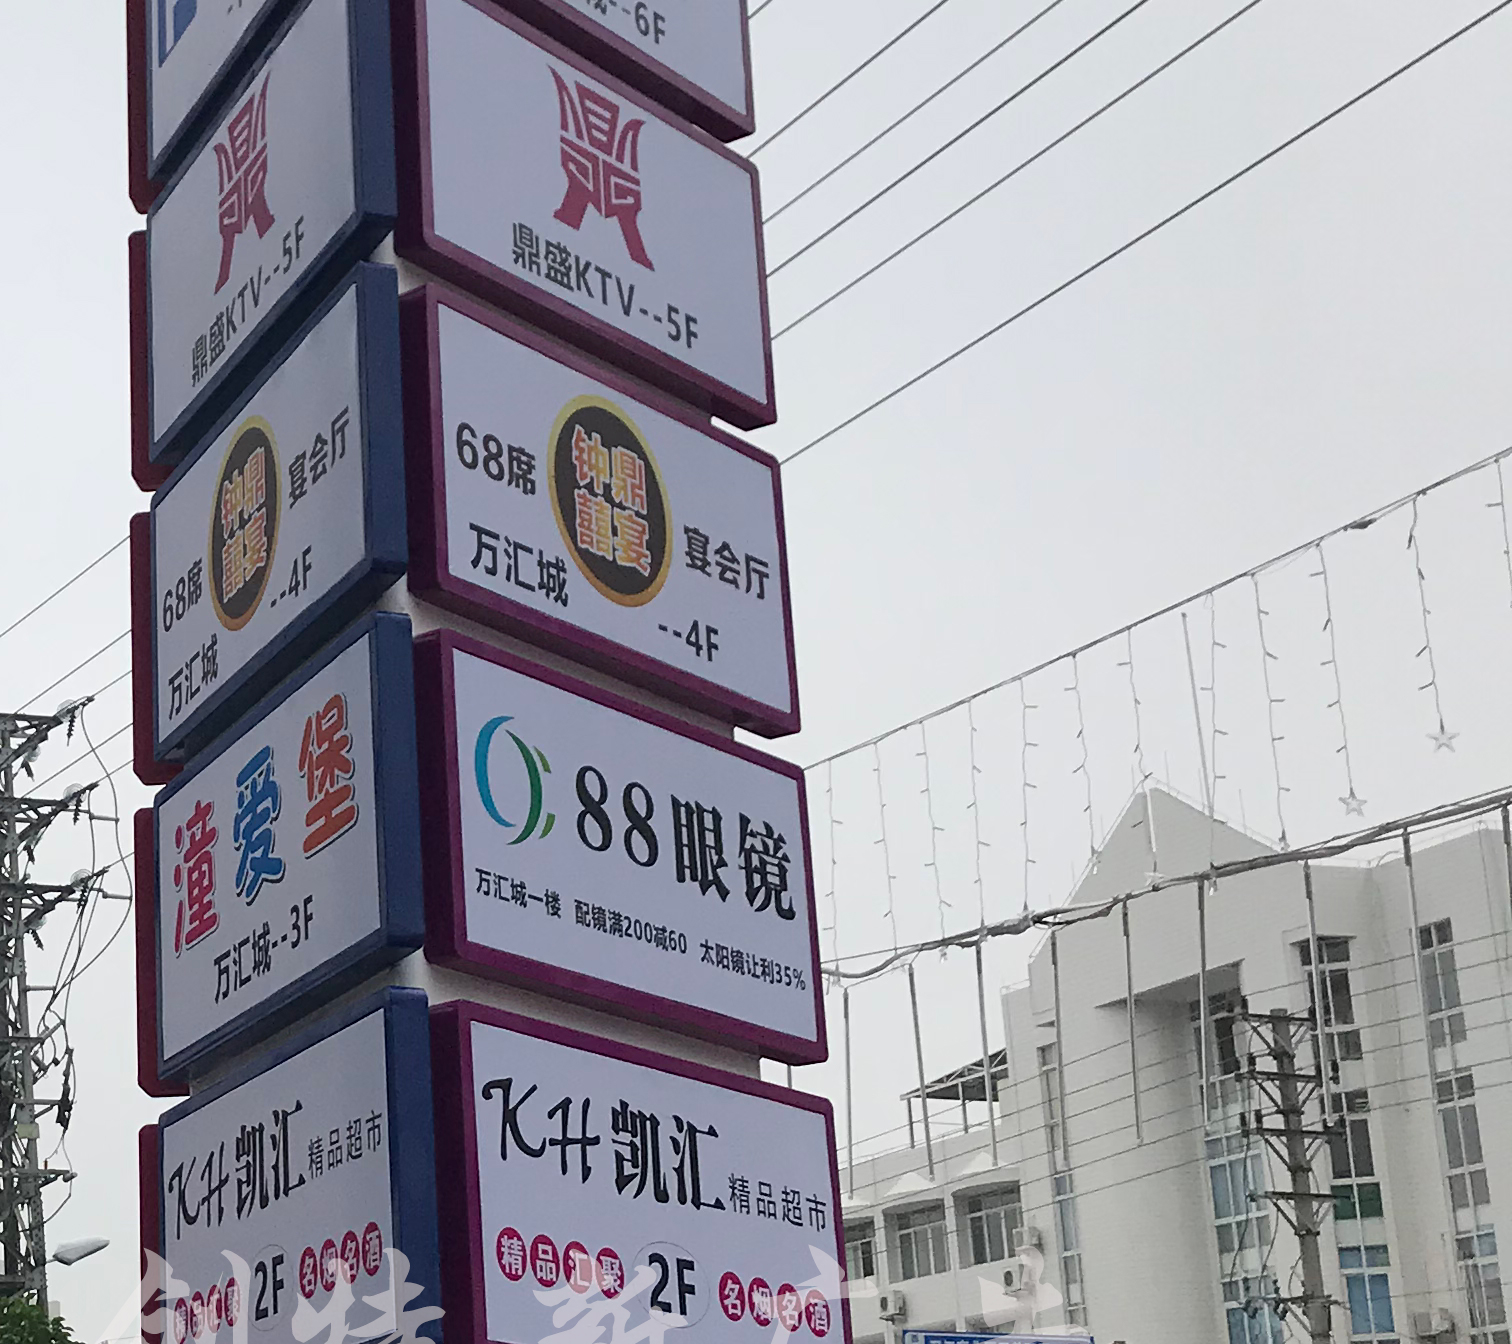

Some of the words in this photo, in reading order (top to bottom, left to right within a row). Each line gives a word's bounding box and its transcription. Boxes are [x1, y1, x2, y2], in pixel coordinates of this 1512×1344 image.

[288, 405, 349, 509] 宴会厅
[455, 421, 536, 496] 68席
[162, 557, 203, 633] 68席
[469, 522, 569, 607] 万汇城
[683, 523, 770, 600] 宴会厅
[168, 632, 218, 721] 万汇城
[576, 765, 796, 921] 88眼镜
[475, 868, 562, 919] 万汇城一楼
[574, 899, 688, 955] 配镜满200减60
[700, 939, 806, 991] 太阳镜让利35%
[307, 1109, 383, 1180] 精品超市
[728, 1173, 827, 1233] 精品超市
[254, 1253, 285, 1322] 2F
[300, 1229, 380, 1299] 名烟名酒
[500, 1234, 624, 1296] 精品汇聚
[648, 1252, 697, 1316] 2F
[722, 1279, 830, 1334] 名烟名酒
